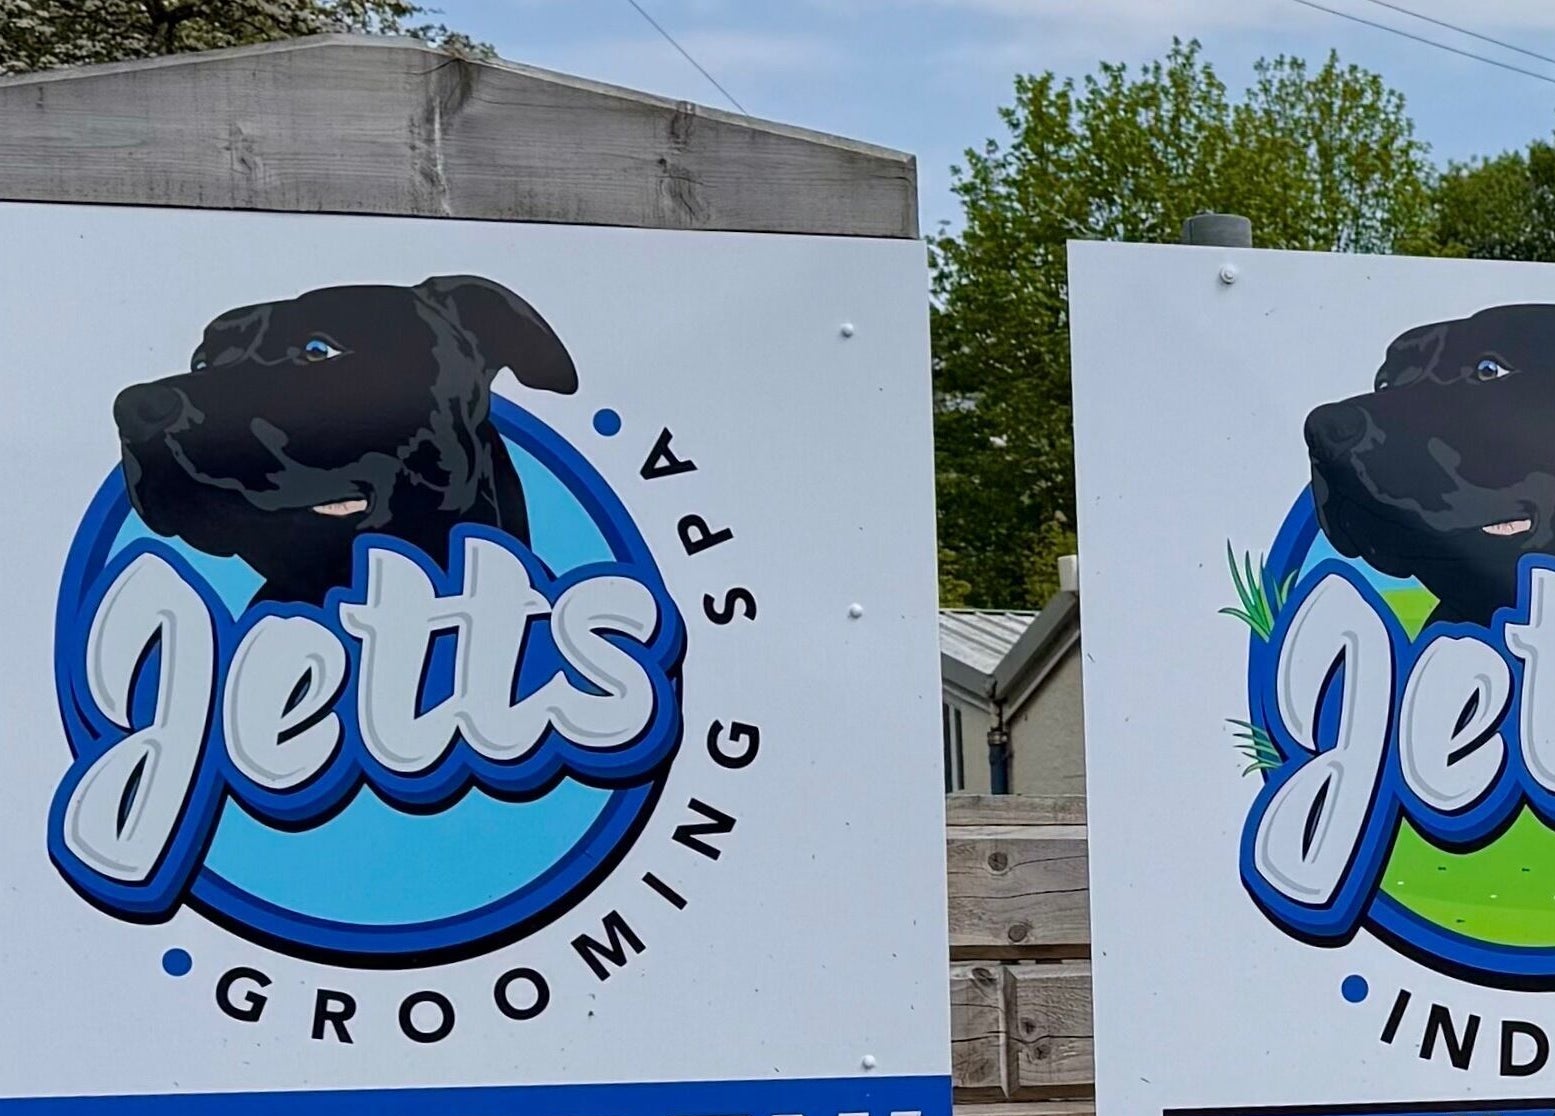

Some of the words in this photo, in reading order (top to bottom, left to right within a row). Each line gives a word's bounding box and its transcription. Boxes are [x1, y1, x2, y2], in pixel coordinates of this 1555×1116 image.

[64, 535, 660, 884] Jetts
[215, 718, 761, 1045] GROOMING
[640, 427, 758, 625] SPA
